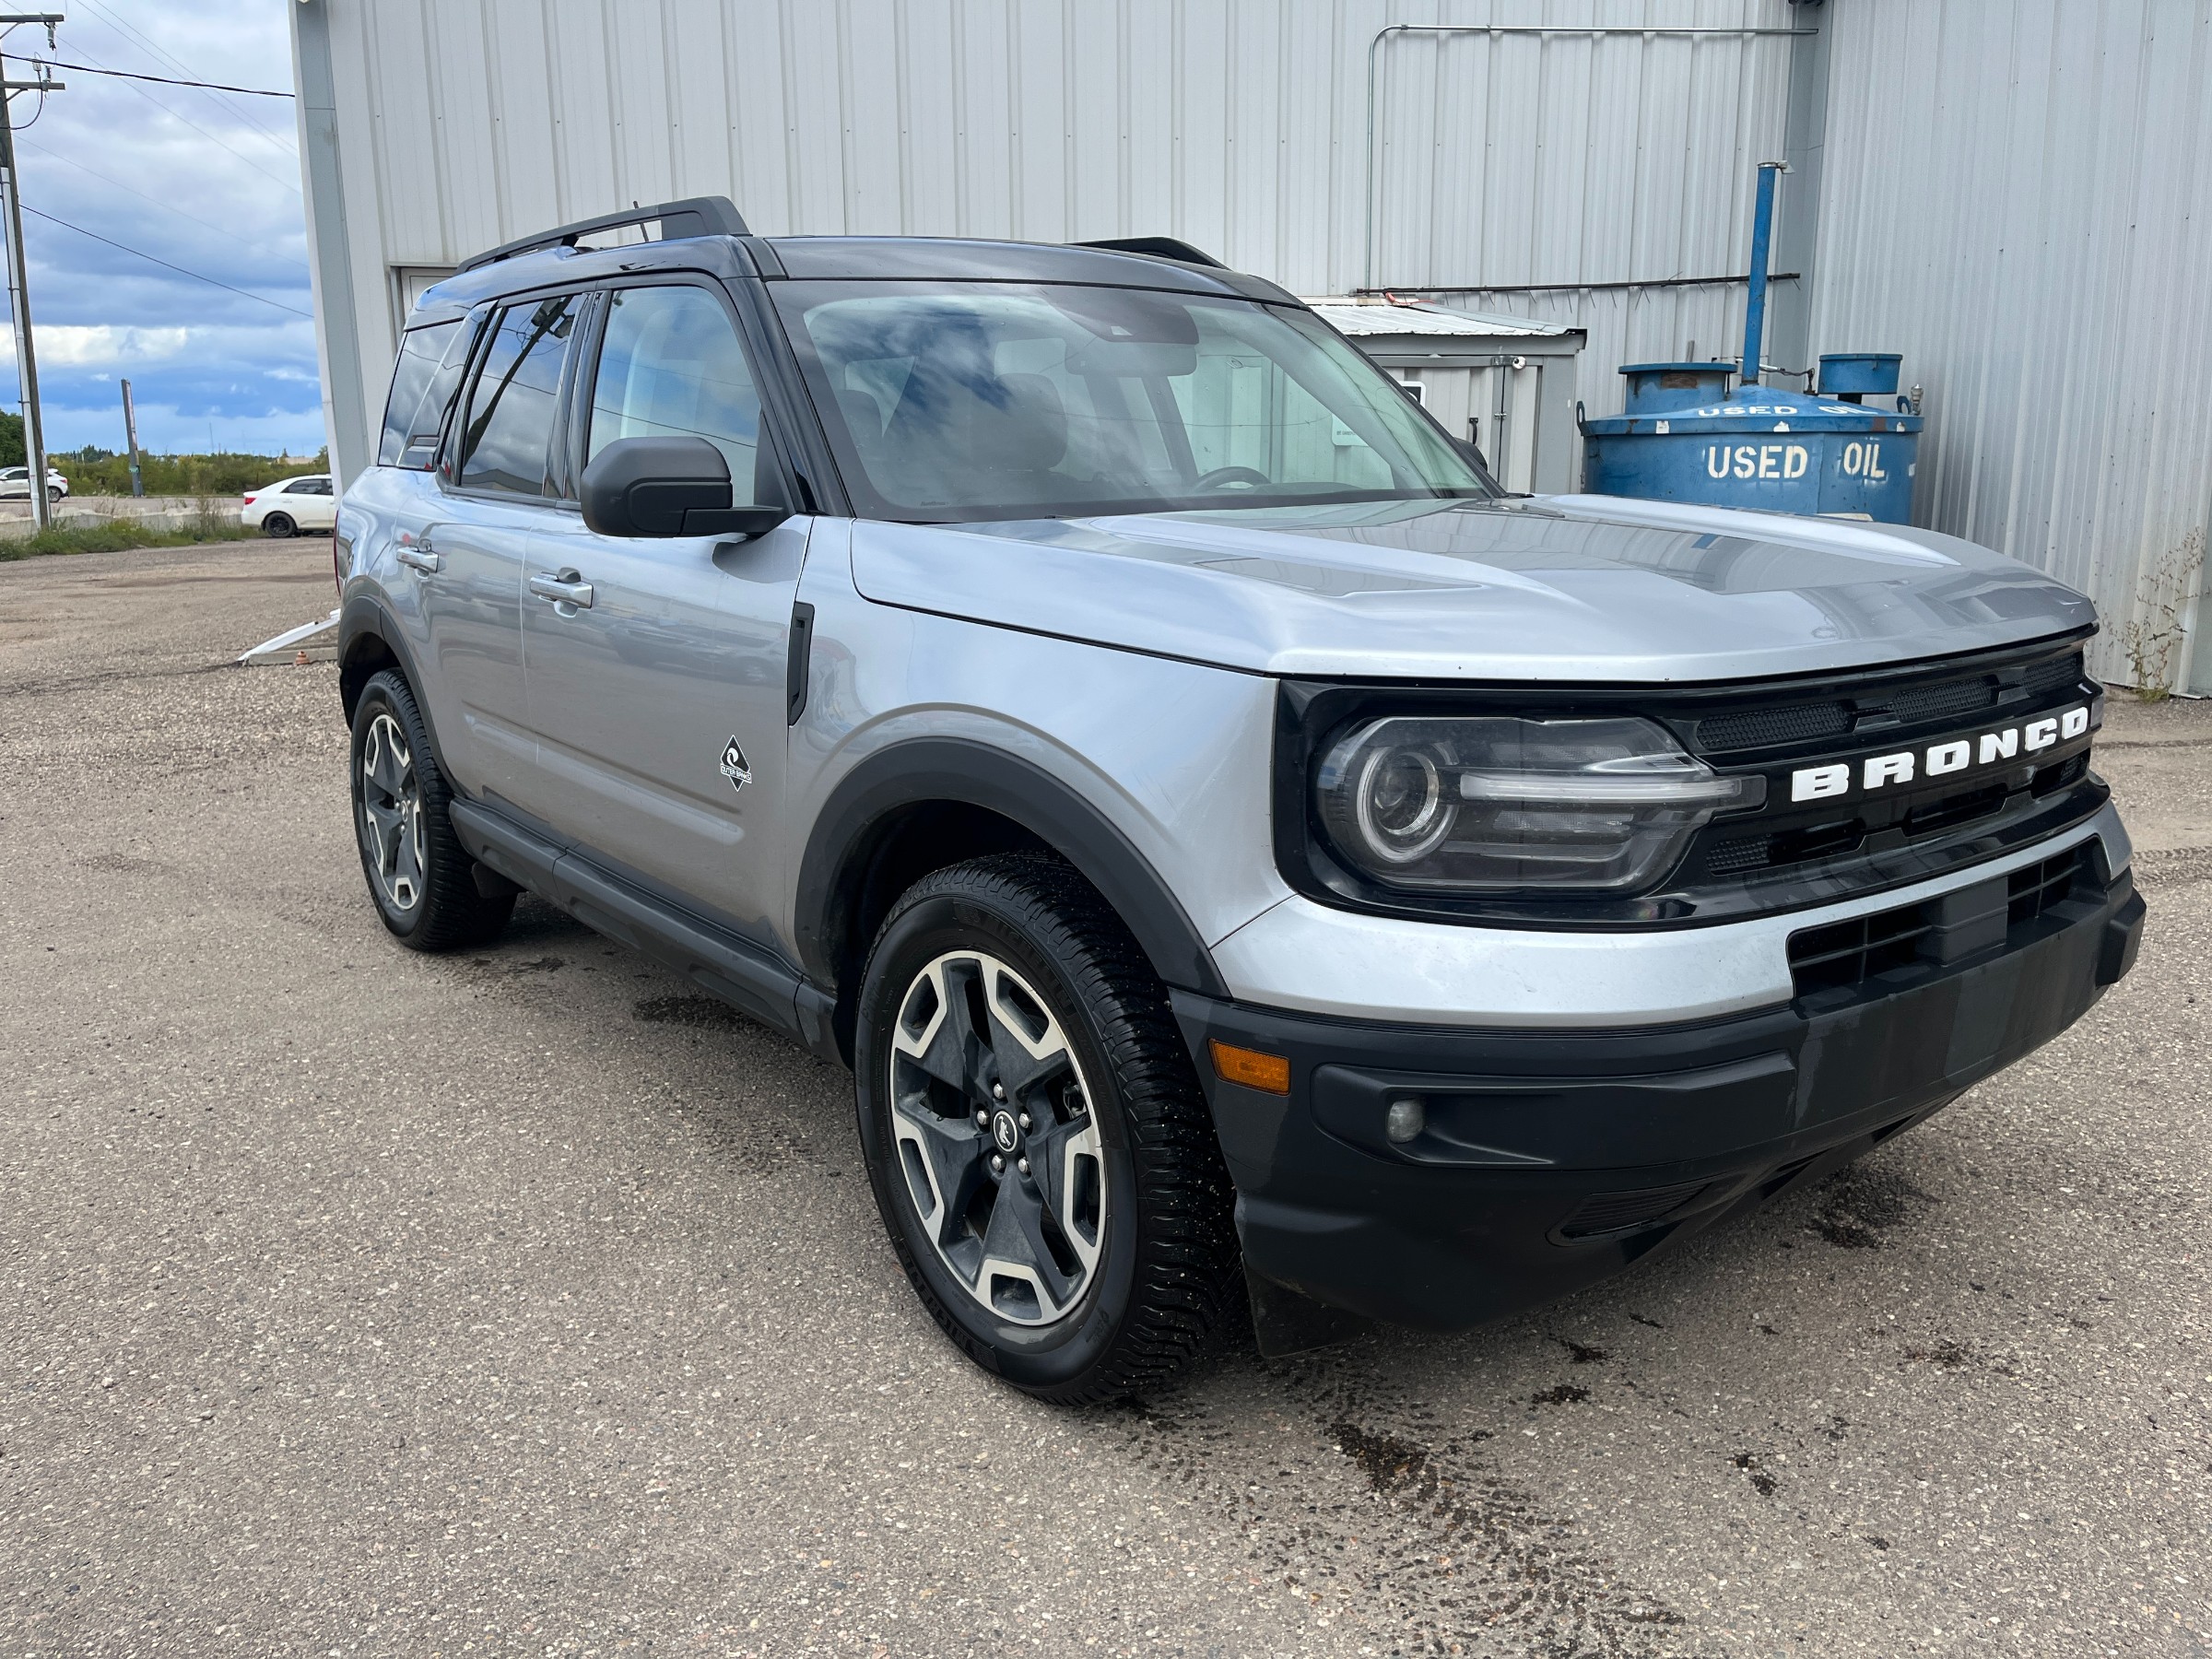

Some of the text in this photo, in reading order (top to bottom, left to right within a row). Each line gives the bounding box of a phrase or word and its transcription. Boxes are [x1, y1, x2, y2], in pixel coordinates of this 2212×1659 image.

[1699, 406, 1878, 417] USED OIL
[1708, 442, 1886, 479] USED OIL
[1792, 707, 2088, 802] BRONCO
